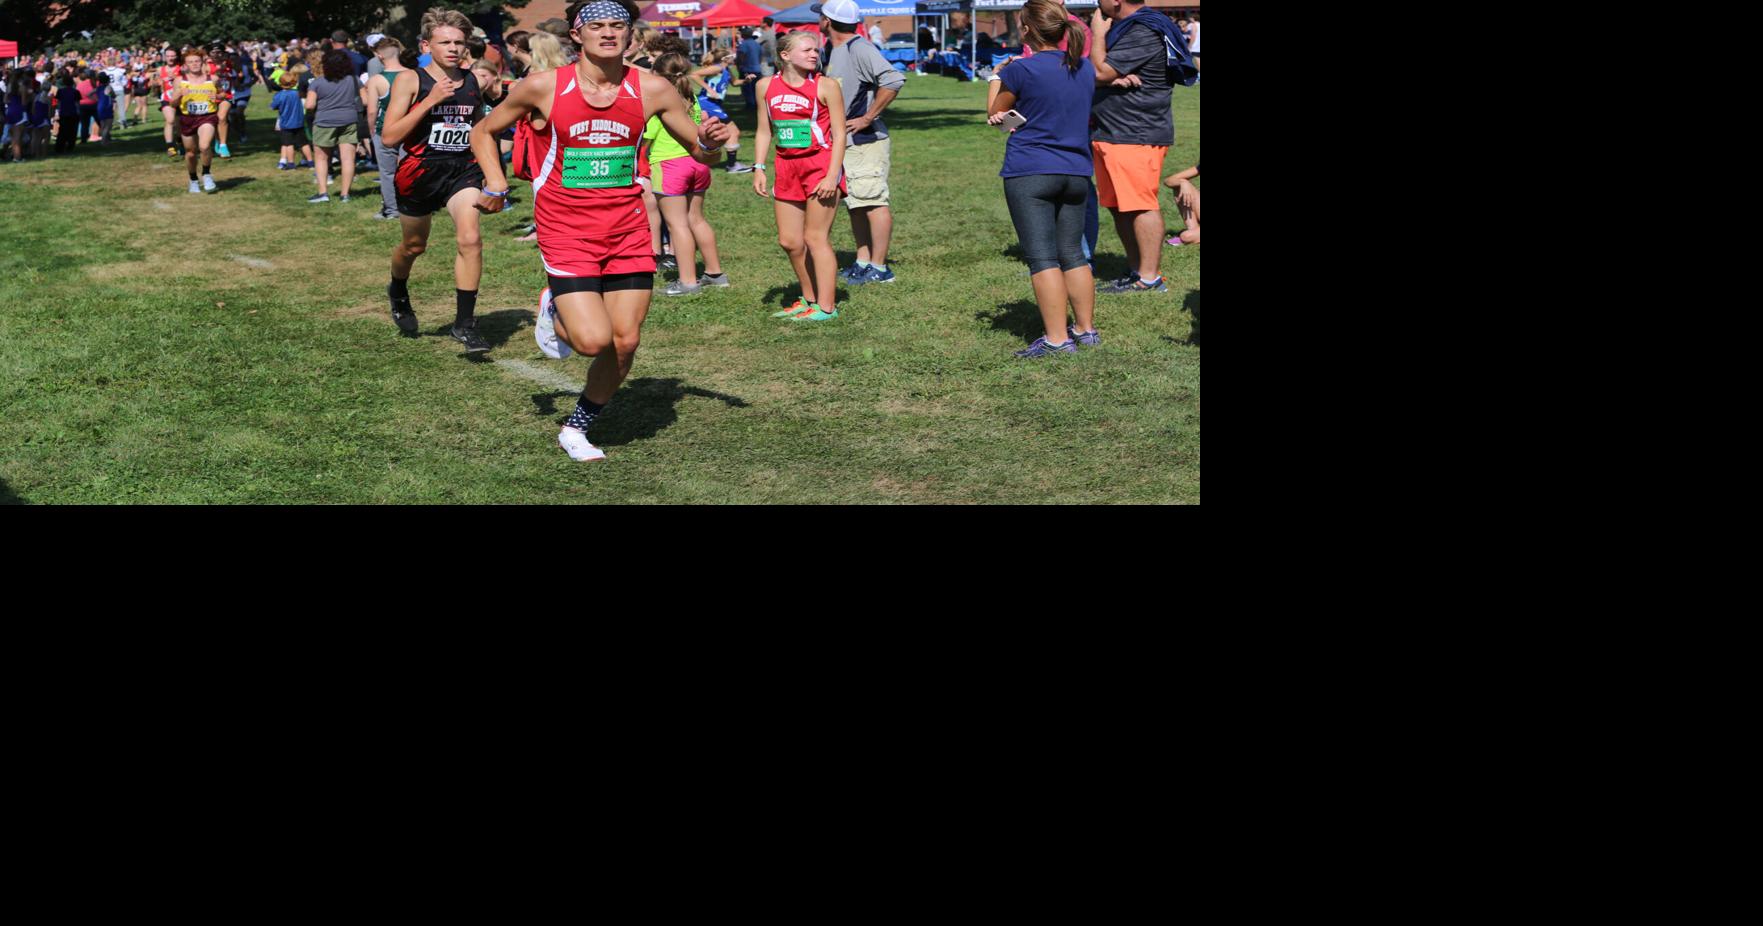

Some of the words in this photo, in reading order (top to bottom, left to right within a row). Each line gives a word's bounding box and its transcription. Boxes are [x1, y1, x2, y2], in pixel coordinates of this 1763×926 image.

[432, 105, 474, 115] LAKEVIEW
[569, 120, 590, 138] WEST
[591, 119, 630, 139] MIDDLESEX
[779, 128, 793, 140] 39
[434, 130, 470, 144] 1020
[590, 160, 609, 176] 35
